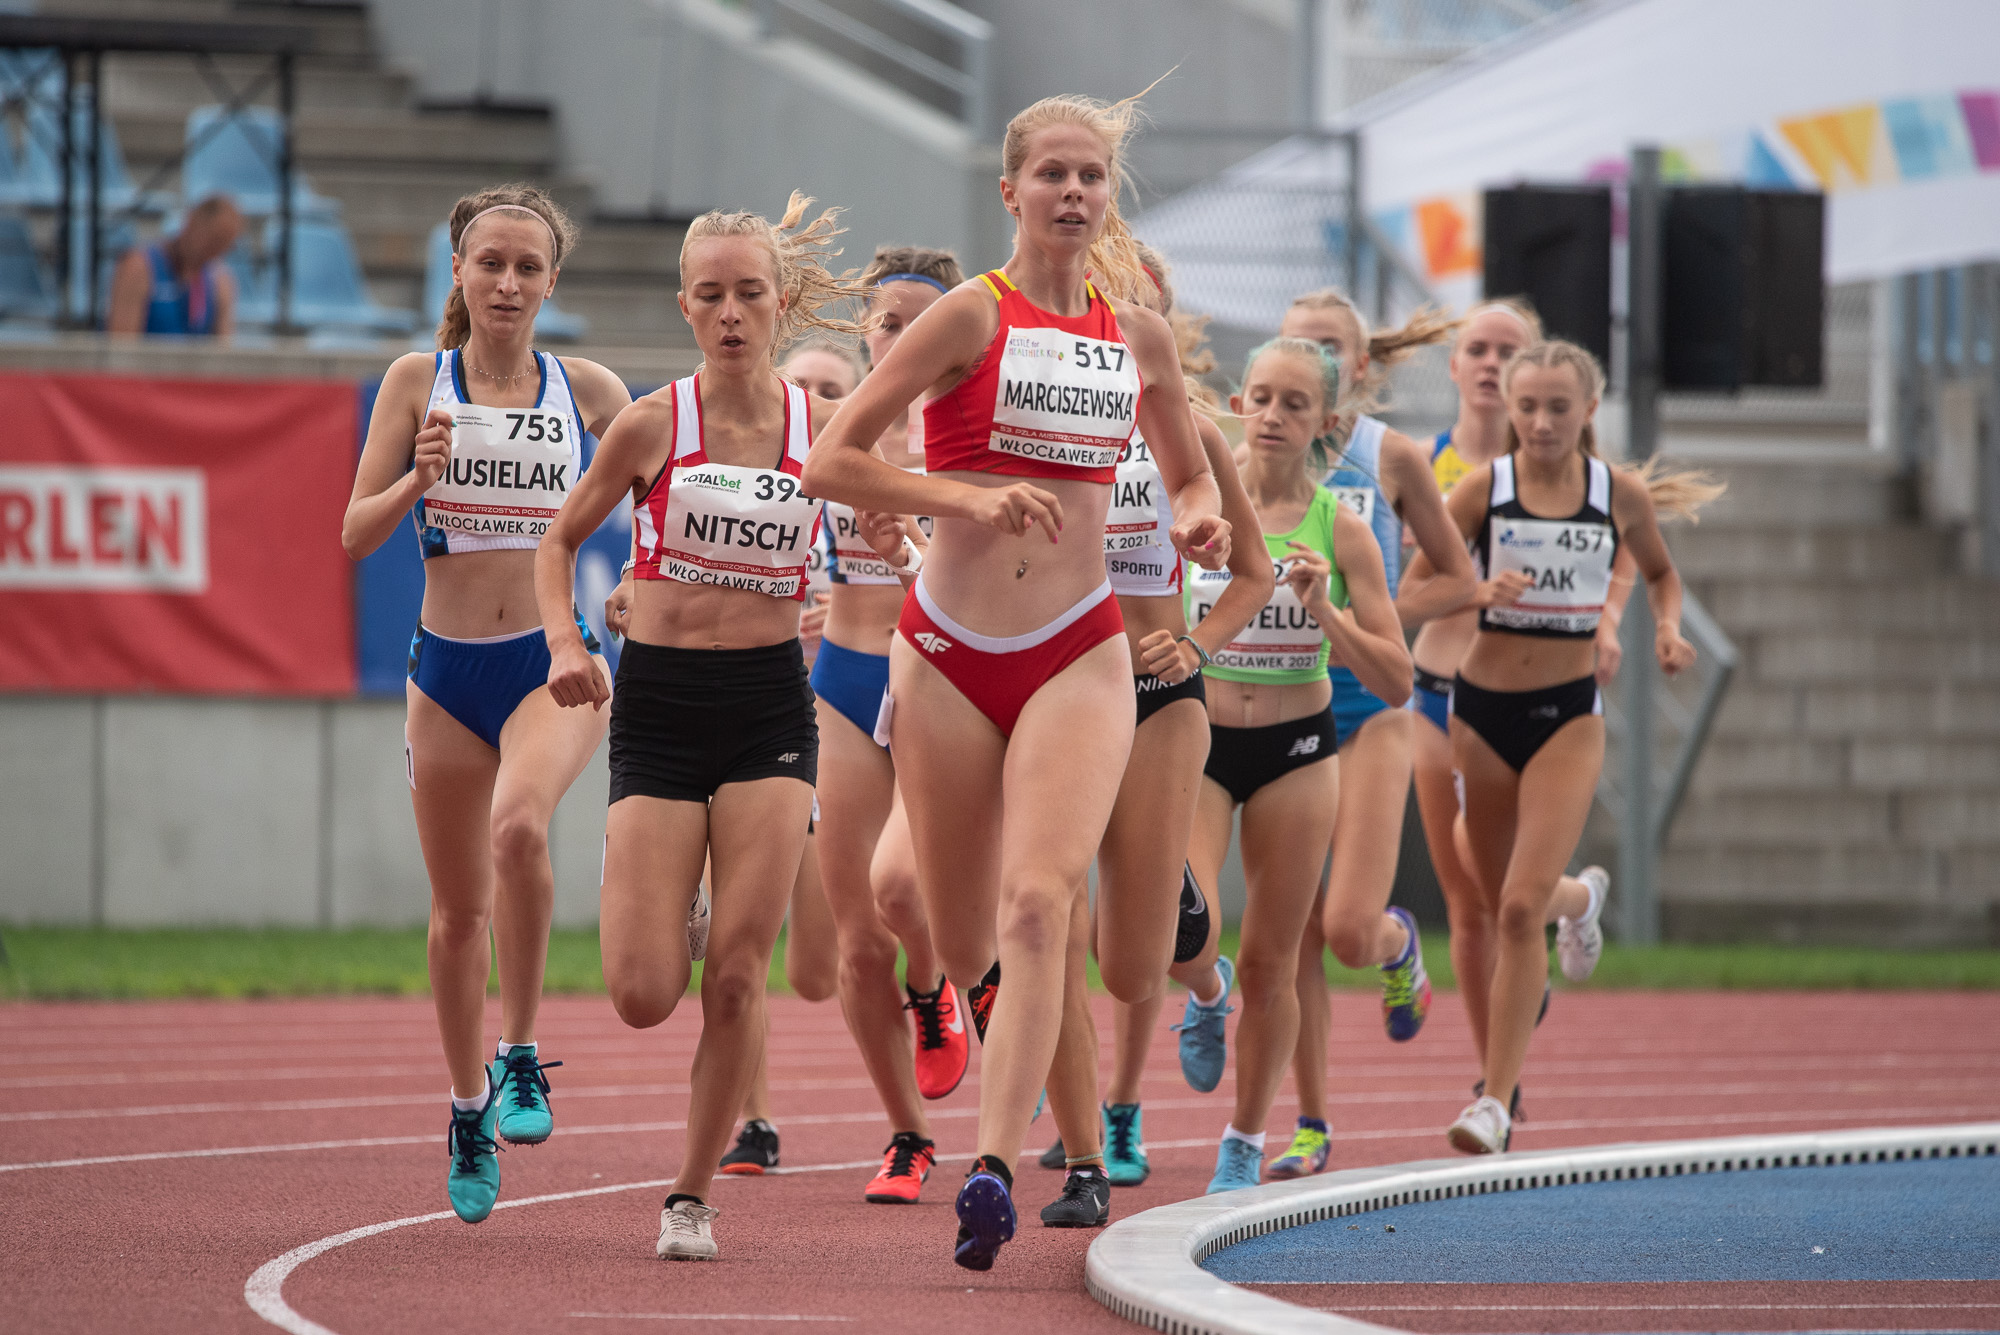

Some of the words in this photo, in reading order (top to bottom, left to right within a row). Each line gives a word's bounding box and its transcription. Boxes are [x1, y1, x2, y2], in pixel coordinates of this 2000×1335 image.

[1075, 341, 1125, 372] 517
[1003, 379, 1133, 422] MARCISZEWSKA
[505, 413, 564, 443] 753
[999, 437, 1096, 464] WŁOCŁAWEK
[1097, 451, 1116, 465] 2021
[433, 513, 525, 534] WŁOCŁAWEK
[463, 505, 520, 515] MISTRZOSTWA
[521, 508, 550, 517] POLSKI
[684, 512, 800, 551] NITSCH
[1119, 534, 1149, 549] 2021
[1556, 528, 1604, 553] 457
[668, 562, 765, 593] WŁOCŁAWEK
[768, 580, 795, 595] 2021
[703, 561, 762, 574] MISTRZOSTWA
[1111, 560, 1163, 577] SPORTU
